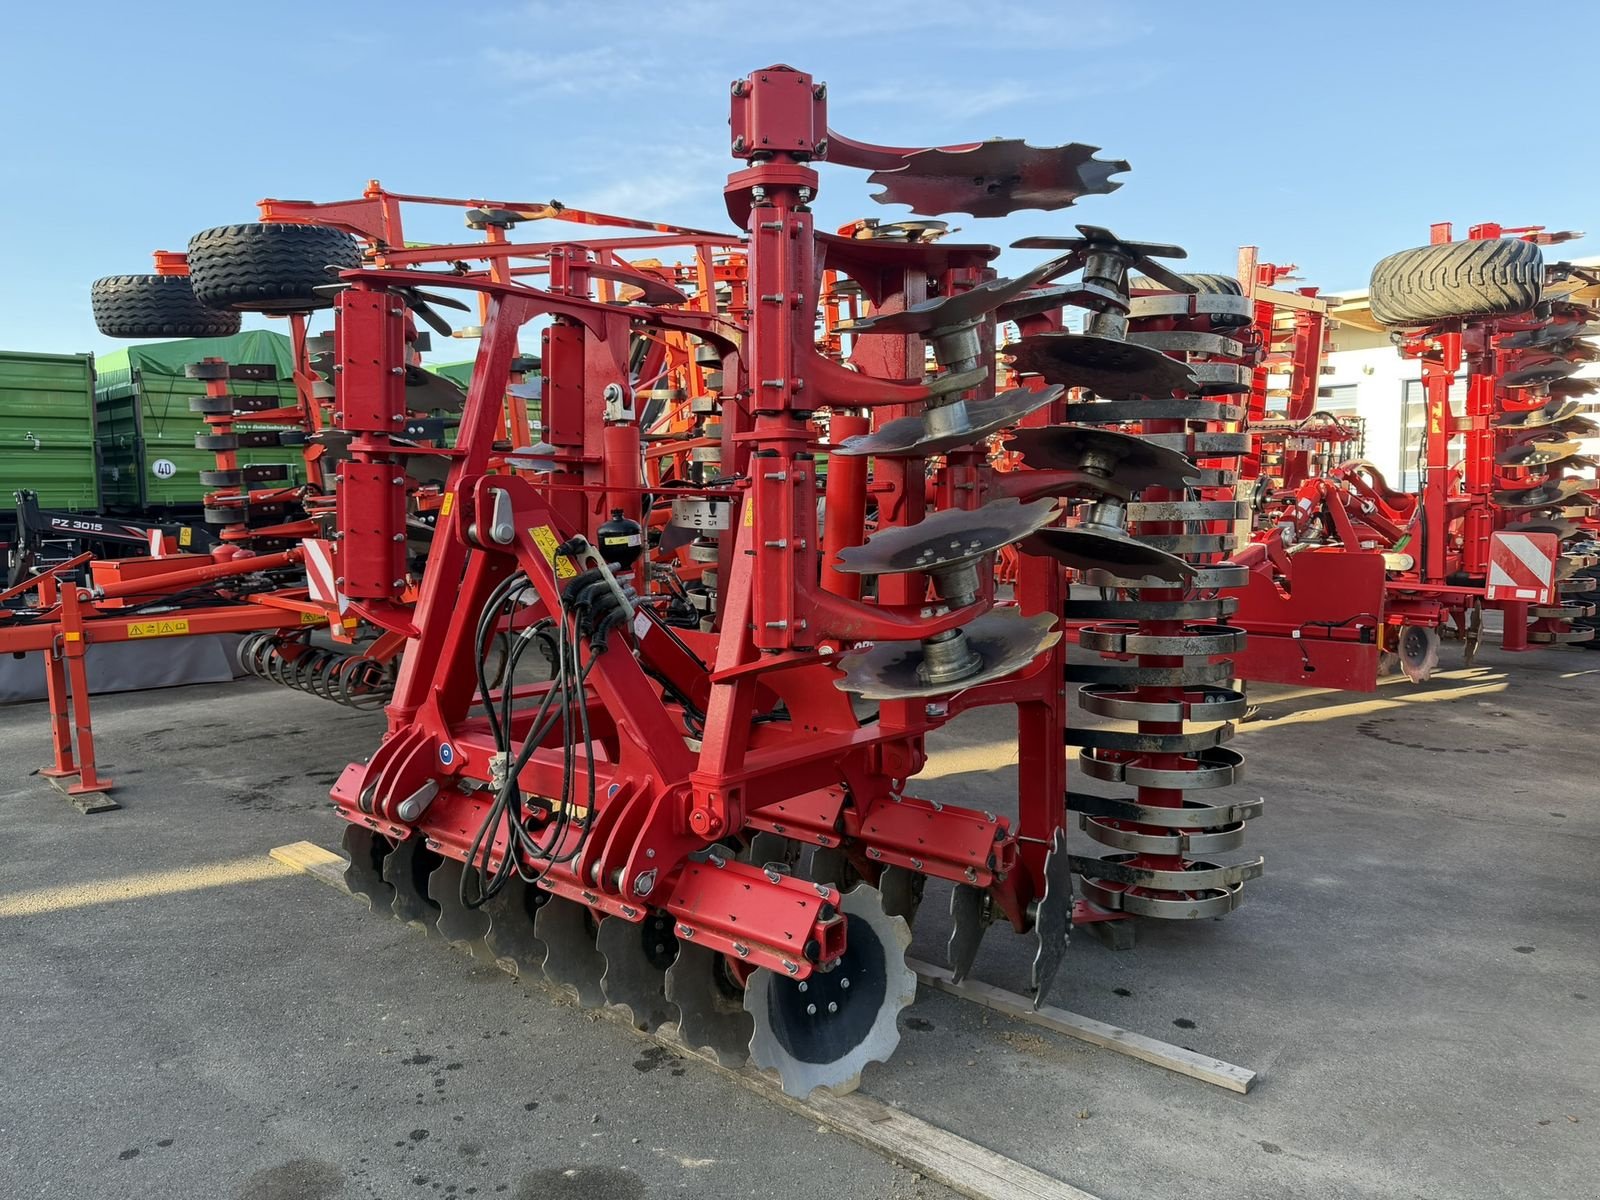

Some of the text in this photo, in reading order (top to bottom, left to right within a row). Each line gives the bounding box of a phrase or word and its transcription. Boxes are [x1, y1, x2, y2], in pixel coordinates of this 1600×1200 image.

[158, 463, 171, 475] 40
[52, 518, 103, 531] PZ 3015
